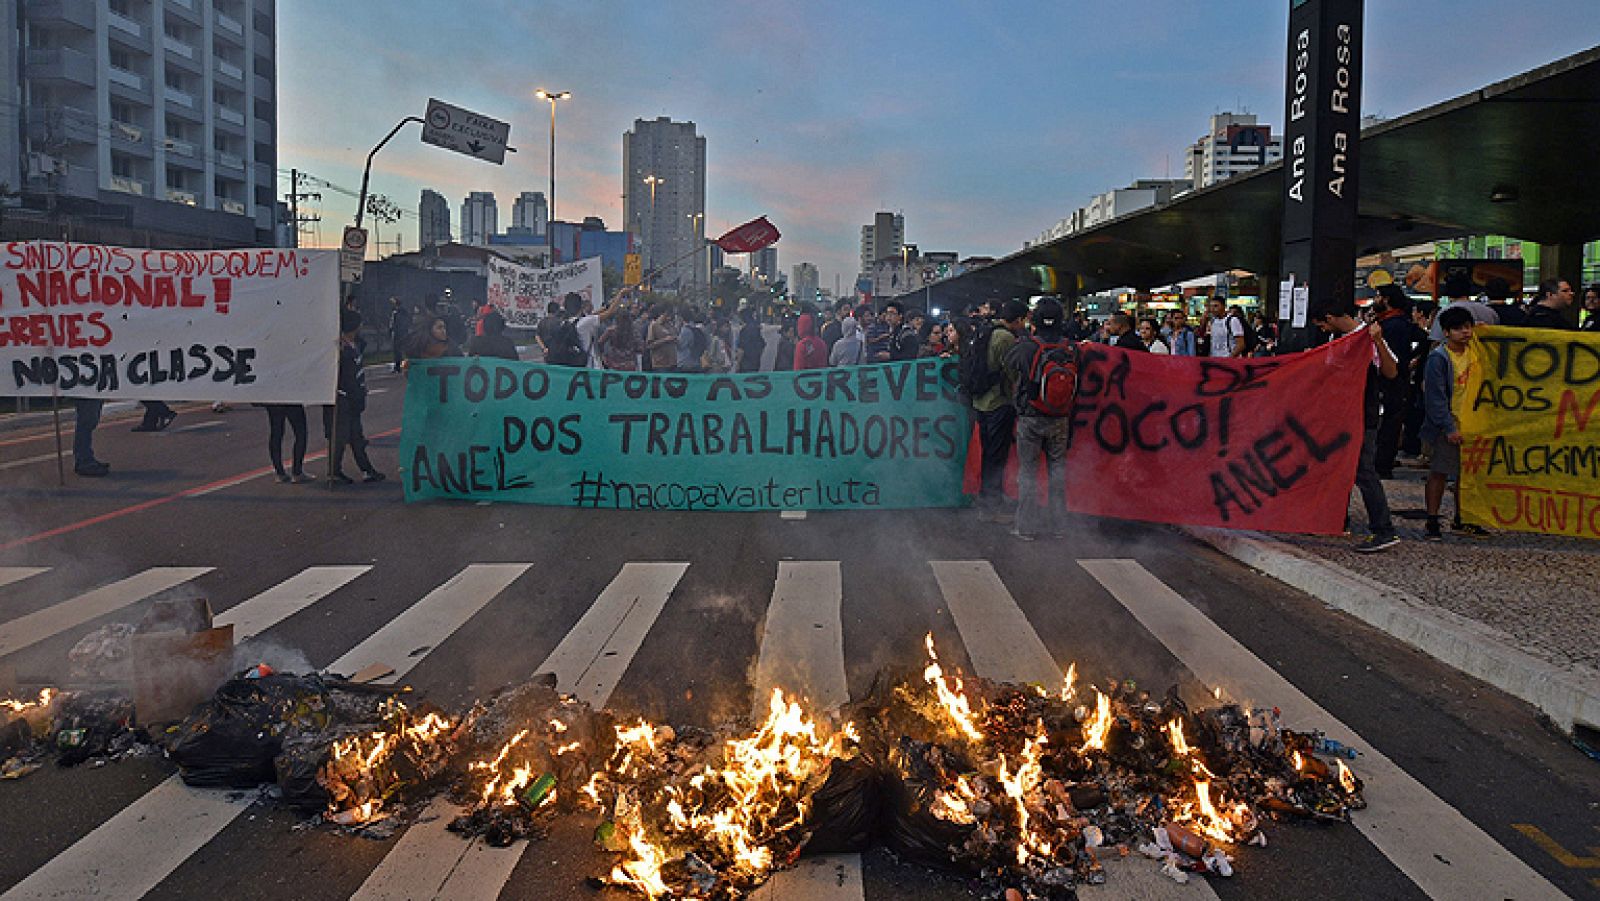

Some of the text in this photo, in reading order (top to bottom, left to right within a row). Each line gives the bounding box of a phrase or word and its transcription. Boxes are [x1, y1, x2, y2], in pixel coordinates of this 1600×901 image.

[1289, 28, 1310, 202] Ana Rosa
[1328, 24, 1351, 199] Ana Rosa
[12, 344, 257, 392] NOSSA CLASSE
[426, 364, 550, 404] TODO
[566, 370, 689, 401] APOIO
[793, 362, 963, 403] GREVES
[1472, 379, 1553, 412] AOS
[503, 407, 957, 460] DOS TRABALHADORES
[411, 445, 535, 494] ANEL
[1209, 414, 1352, 522] ANEL
